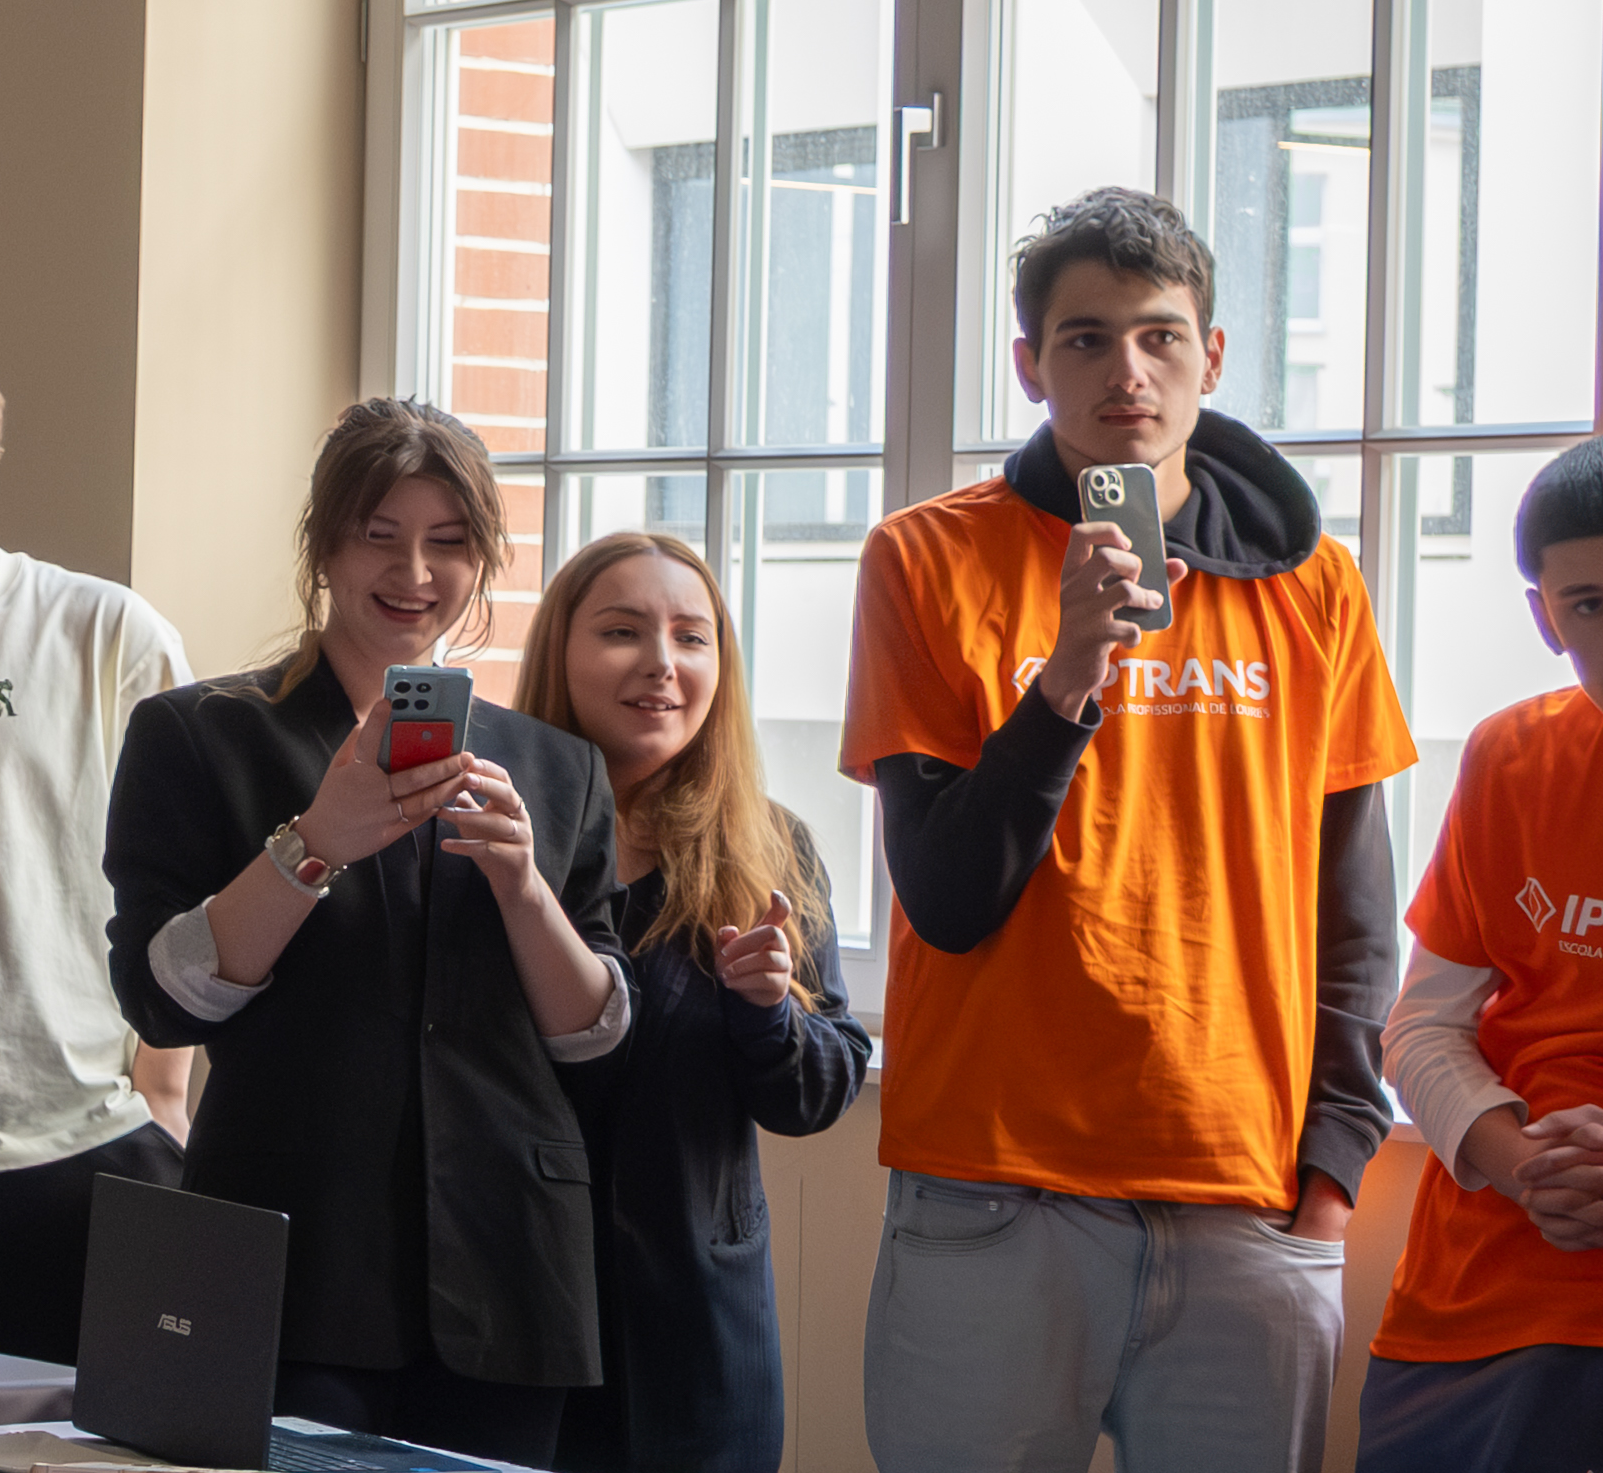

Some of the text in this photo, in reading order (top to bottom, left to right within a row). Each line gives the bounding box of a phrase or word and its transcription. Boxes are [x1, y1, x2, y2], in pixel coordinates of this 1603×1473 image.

[1092, 657, 1272, 701] PTRANS
[1209, 702, 1227, 715] DE
[156, 1313, 192, 1336] ASUS
